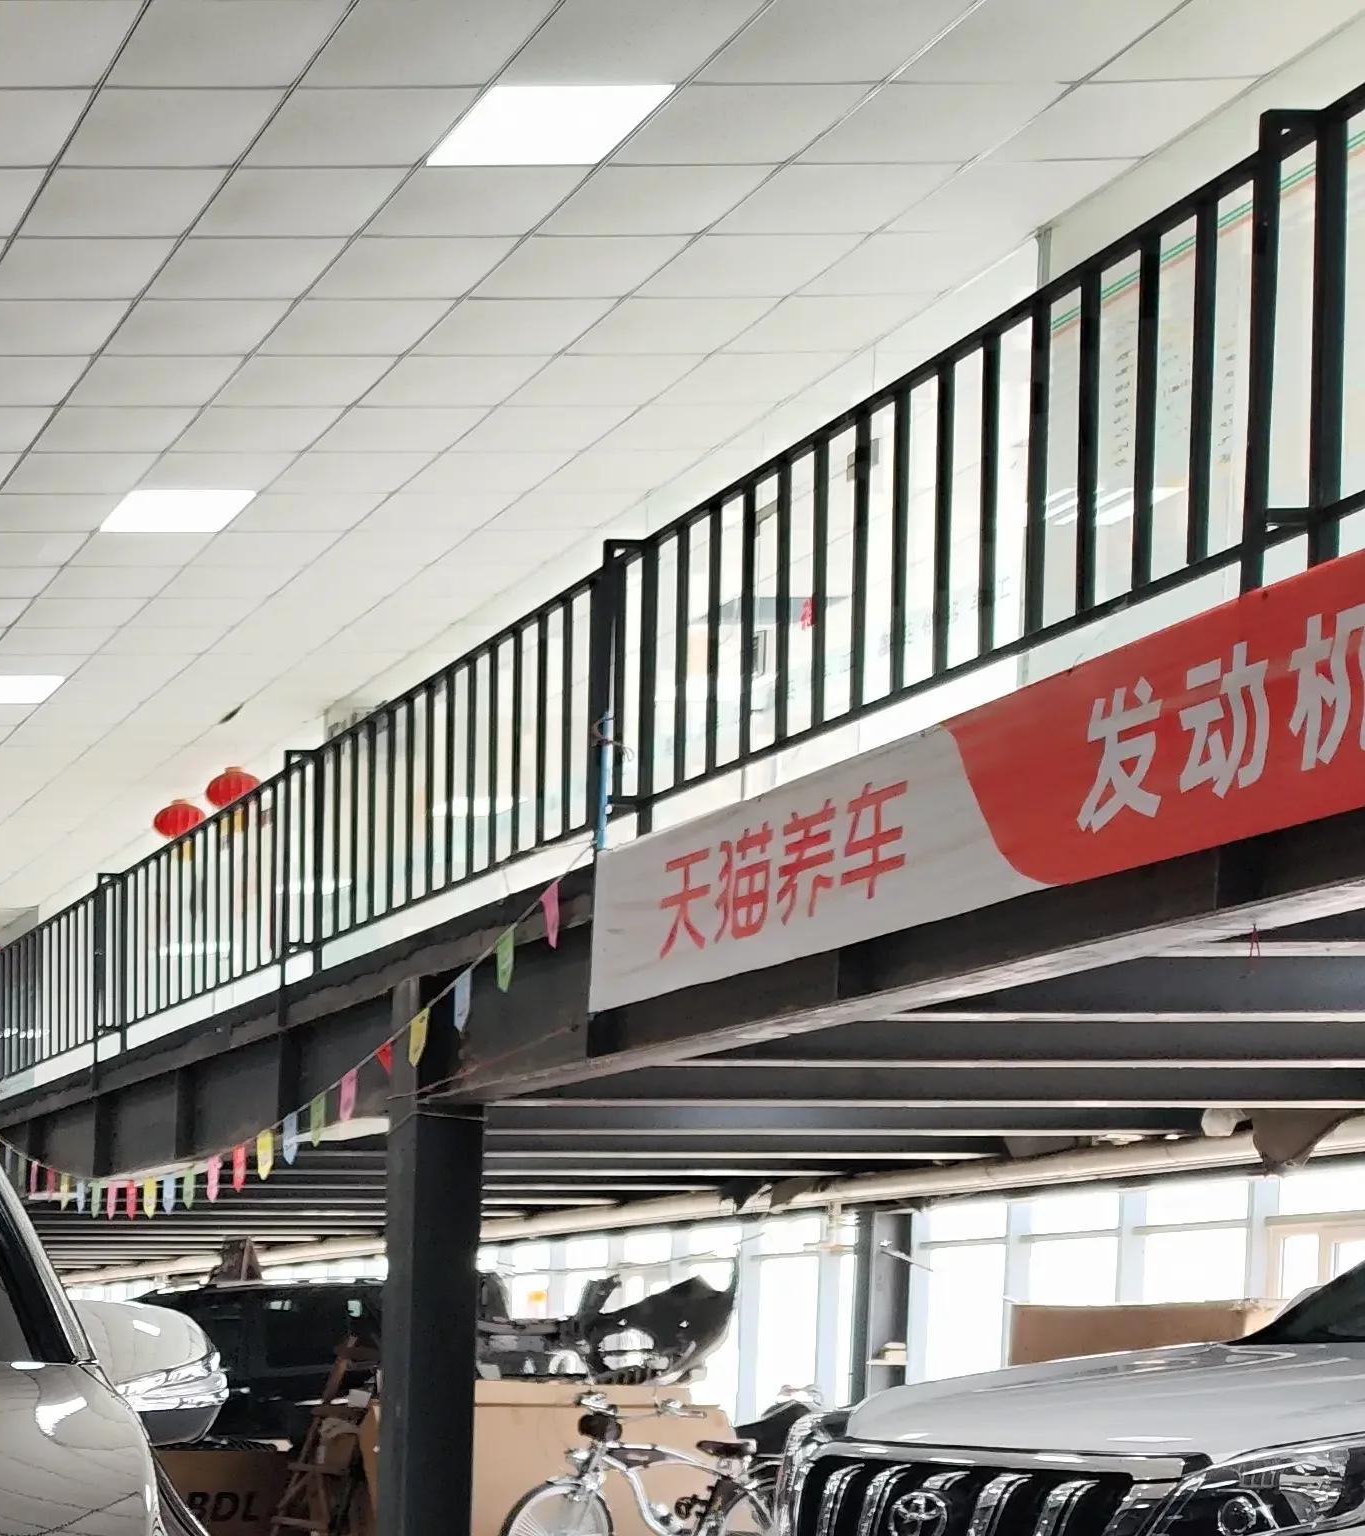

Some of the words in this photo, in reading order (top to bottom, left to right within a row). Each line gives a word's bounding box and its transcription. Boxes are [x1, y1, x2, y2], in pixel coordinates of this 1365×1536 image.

[1076, 603, 1365, 833] 发动机
[660, 781, 907, 959] 天猫养车
